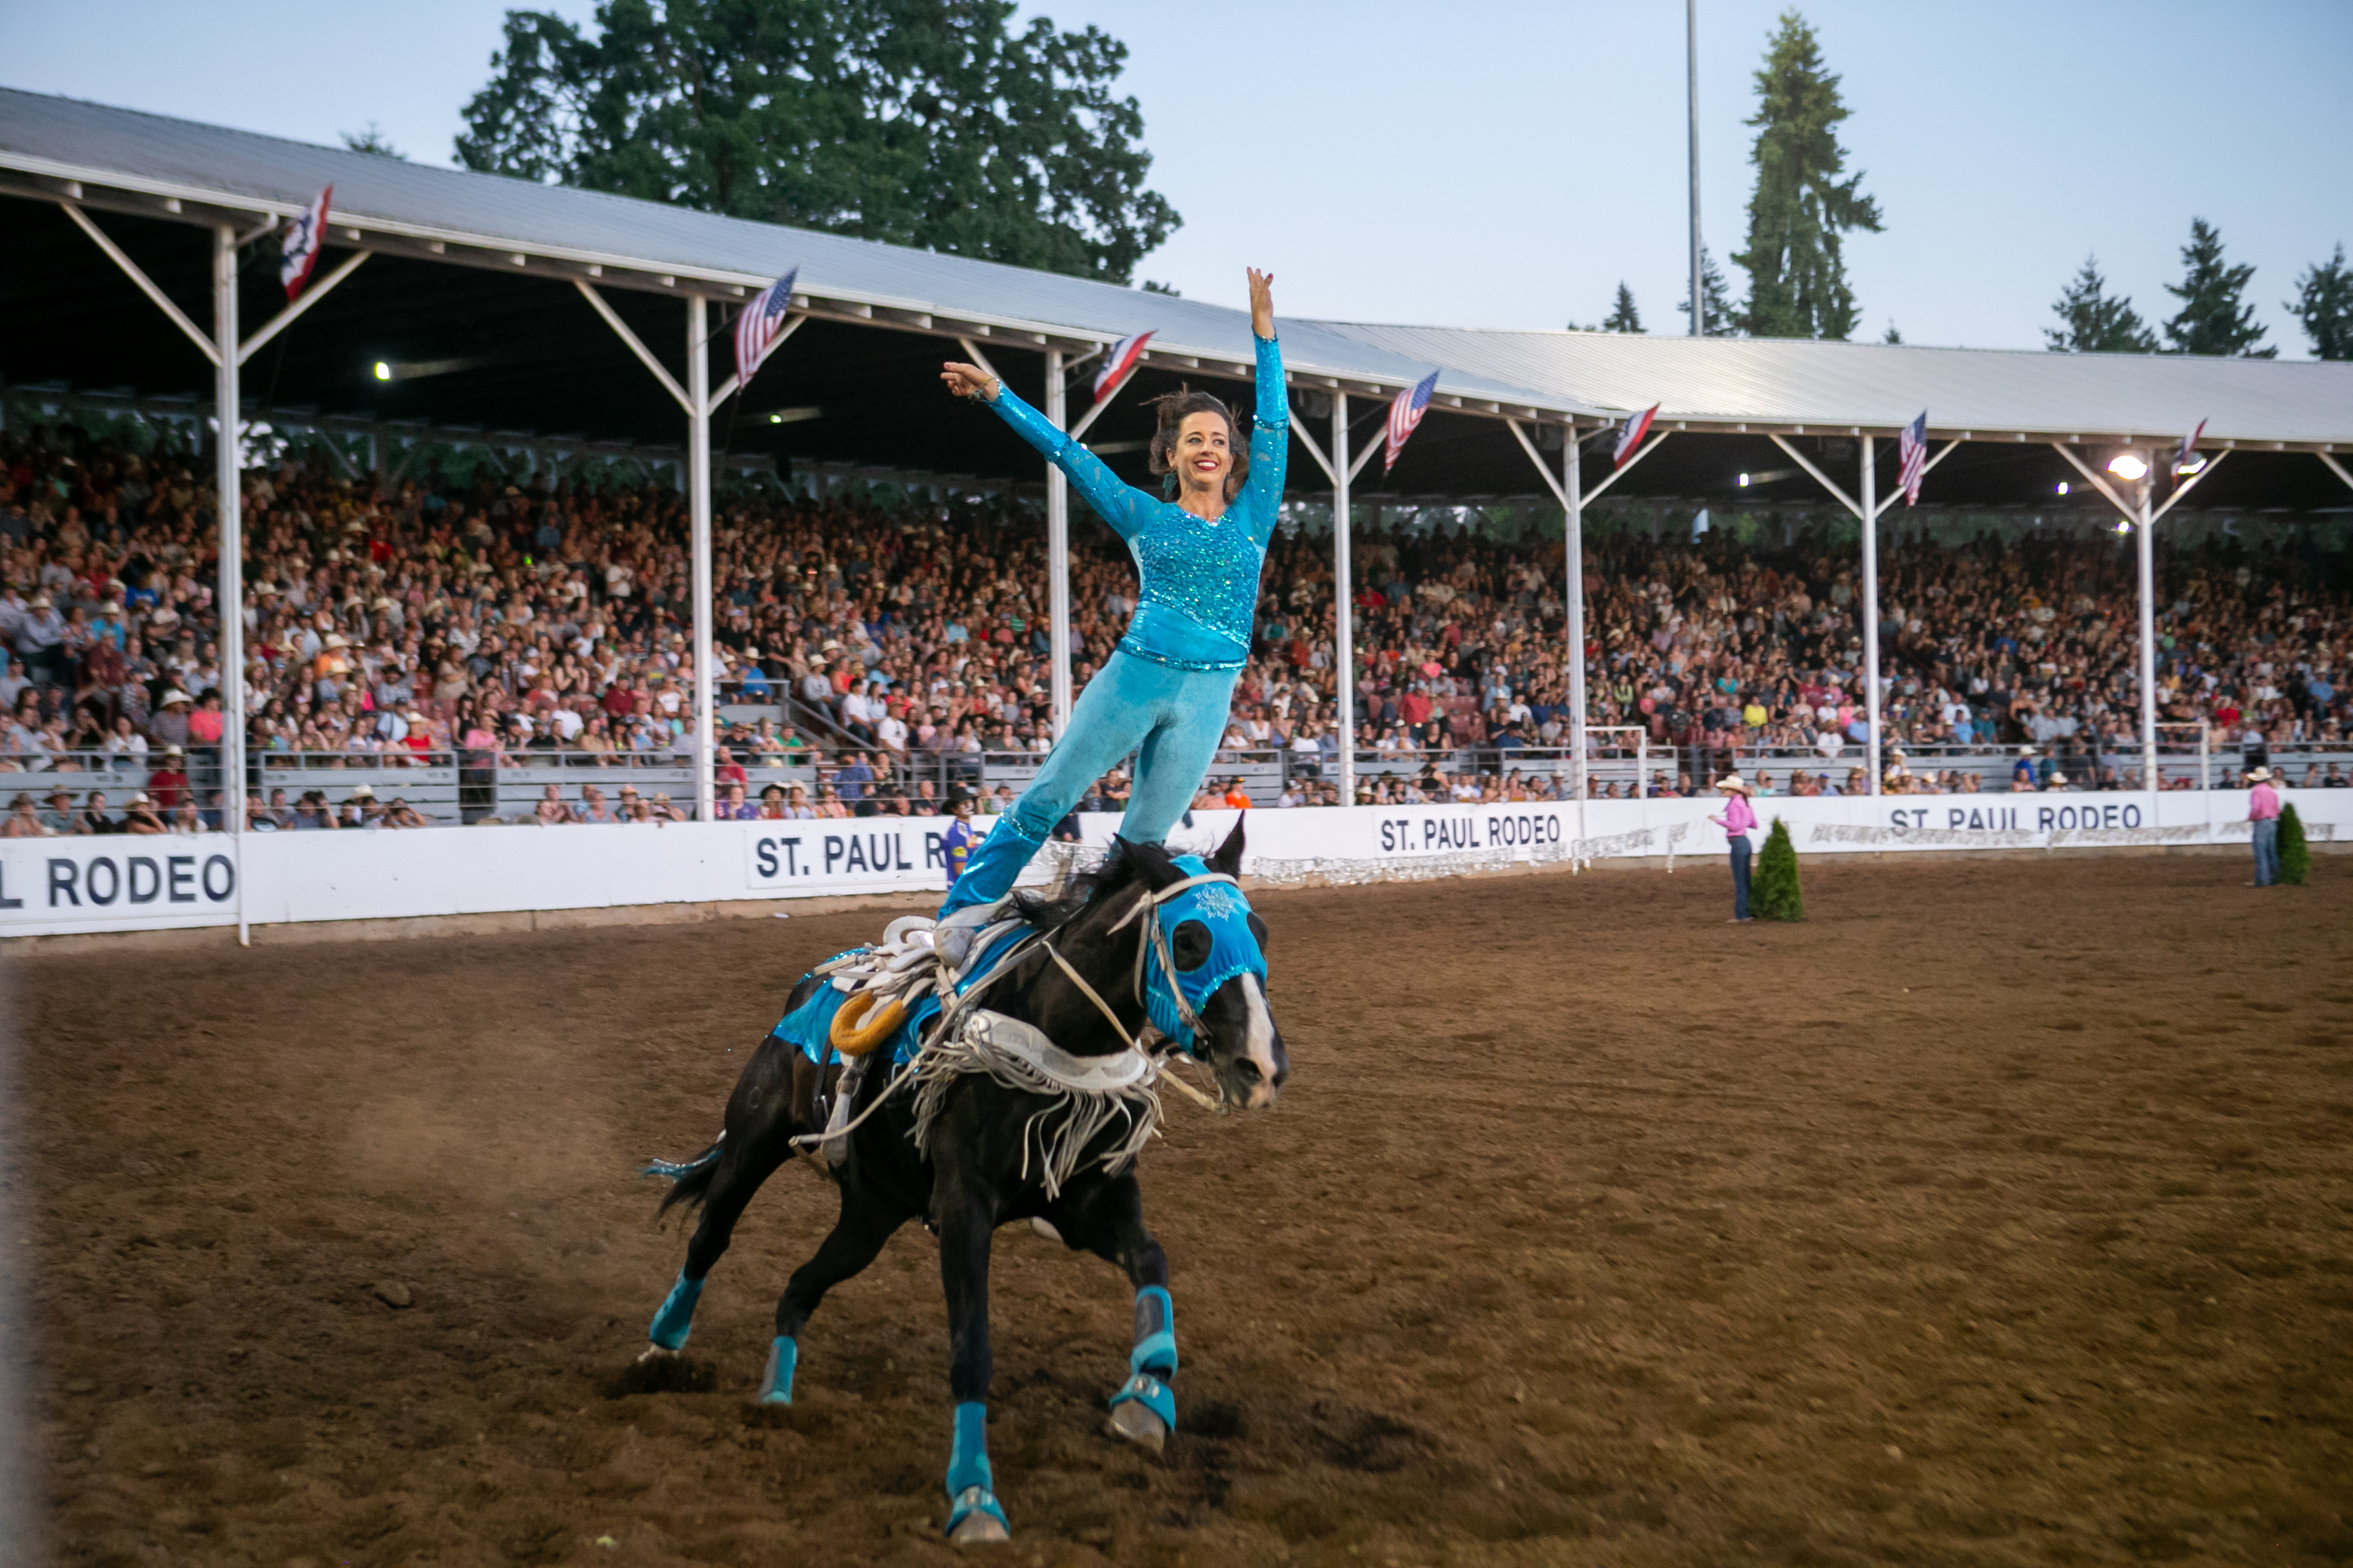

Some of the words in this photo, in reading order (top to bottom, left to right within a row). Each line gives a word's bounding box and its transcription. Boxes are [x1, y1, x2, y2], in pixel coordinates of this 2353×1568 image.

[1381, 819, 1414, 851] ST.
[1425, 818, 1479, 849] PAUL
[1489, 815, 1560, 845] RODEO
[2039, 804, 2141, 832] RODEO
[756, 837, 809, 876] ST.
[825, 833, 912, 873] PAUL
[47, 854, 235, 906] RODEO
